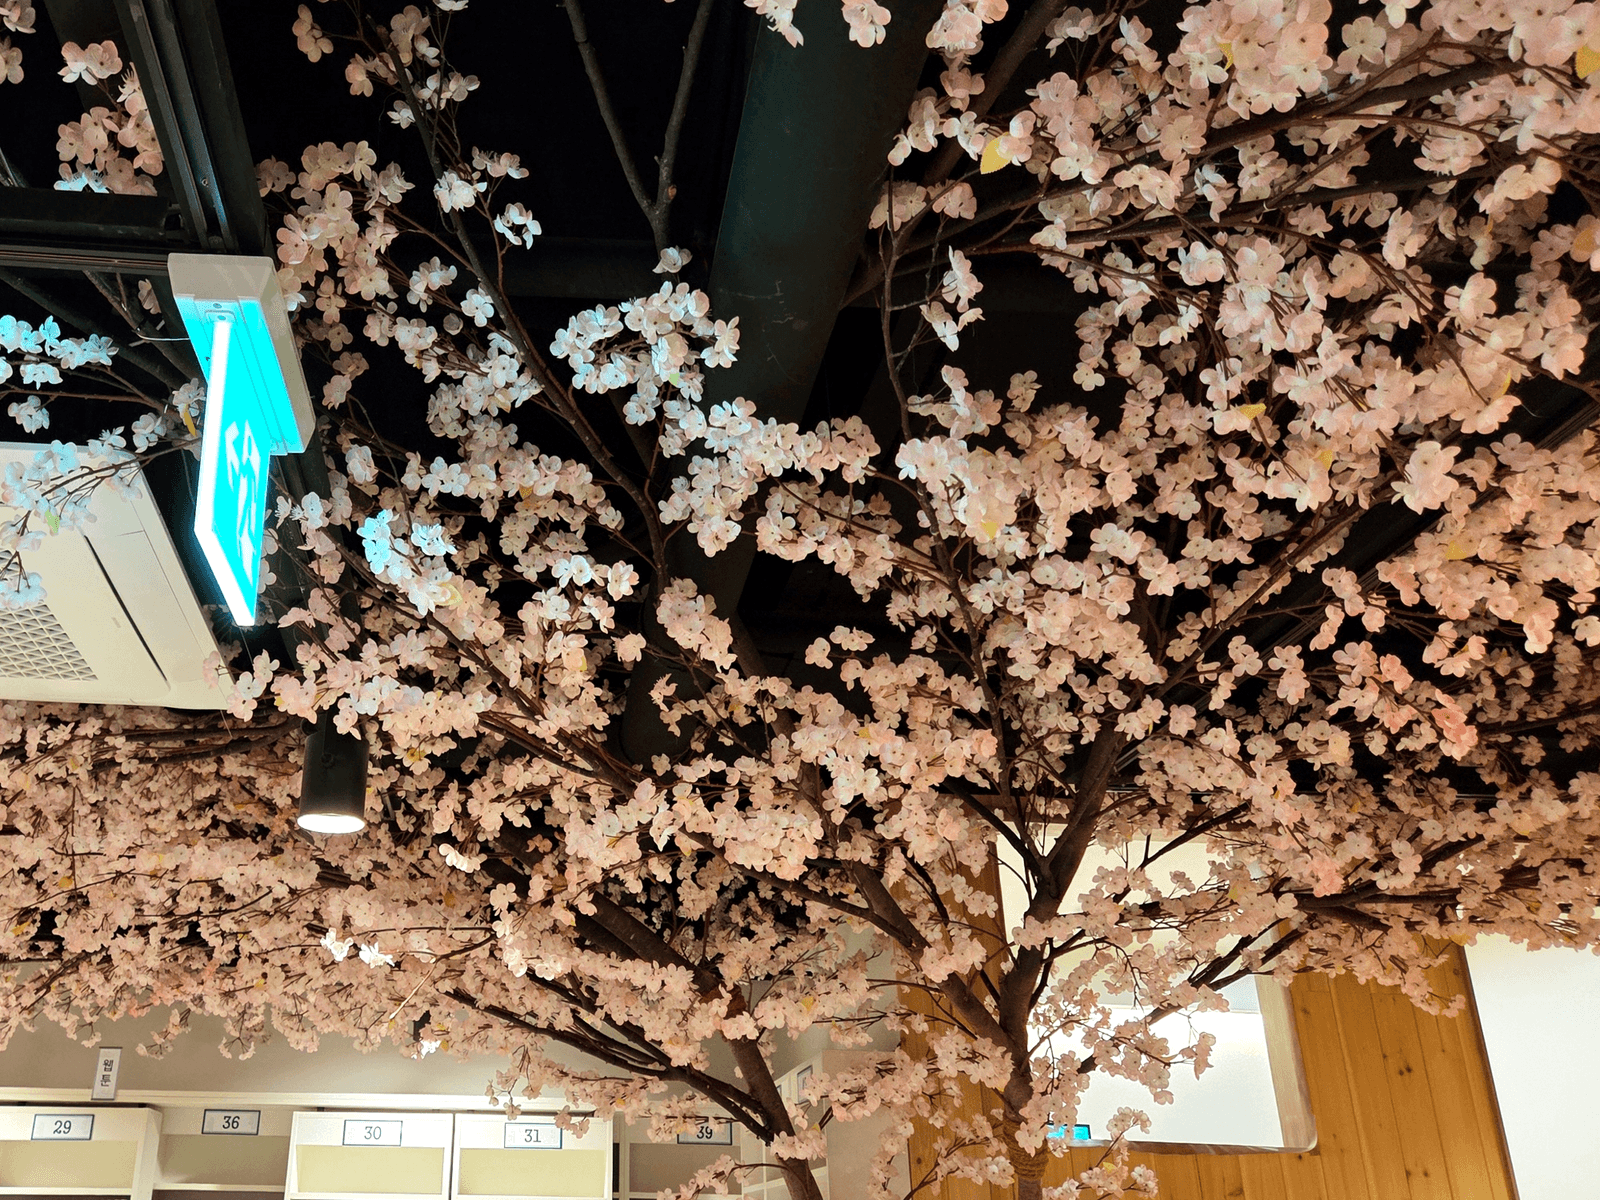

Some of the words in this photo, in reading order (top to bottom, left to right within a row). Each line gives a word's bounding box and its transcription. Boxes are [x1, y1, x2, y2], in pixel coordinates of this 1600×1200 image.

[100, 1059, 114, 1087] 웹툰
[52, 1119, 72, 1135] 29
[222, 1115, 240, 1130] 36
[364, 1126, 382, 1140] 30
[524, 1129, 542, 1143] 31
[696, 1125, 713, 1140] 39
